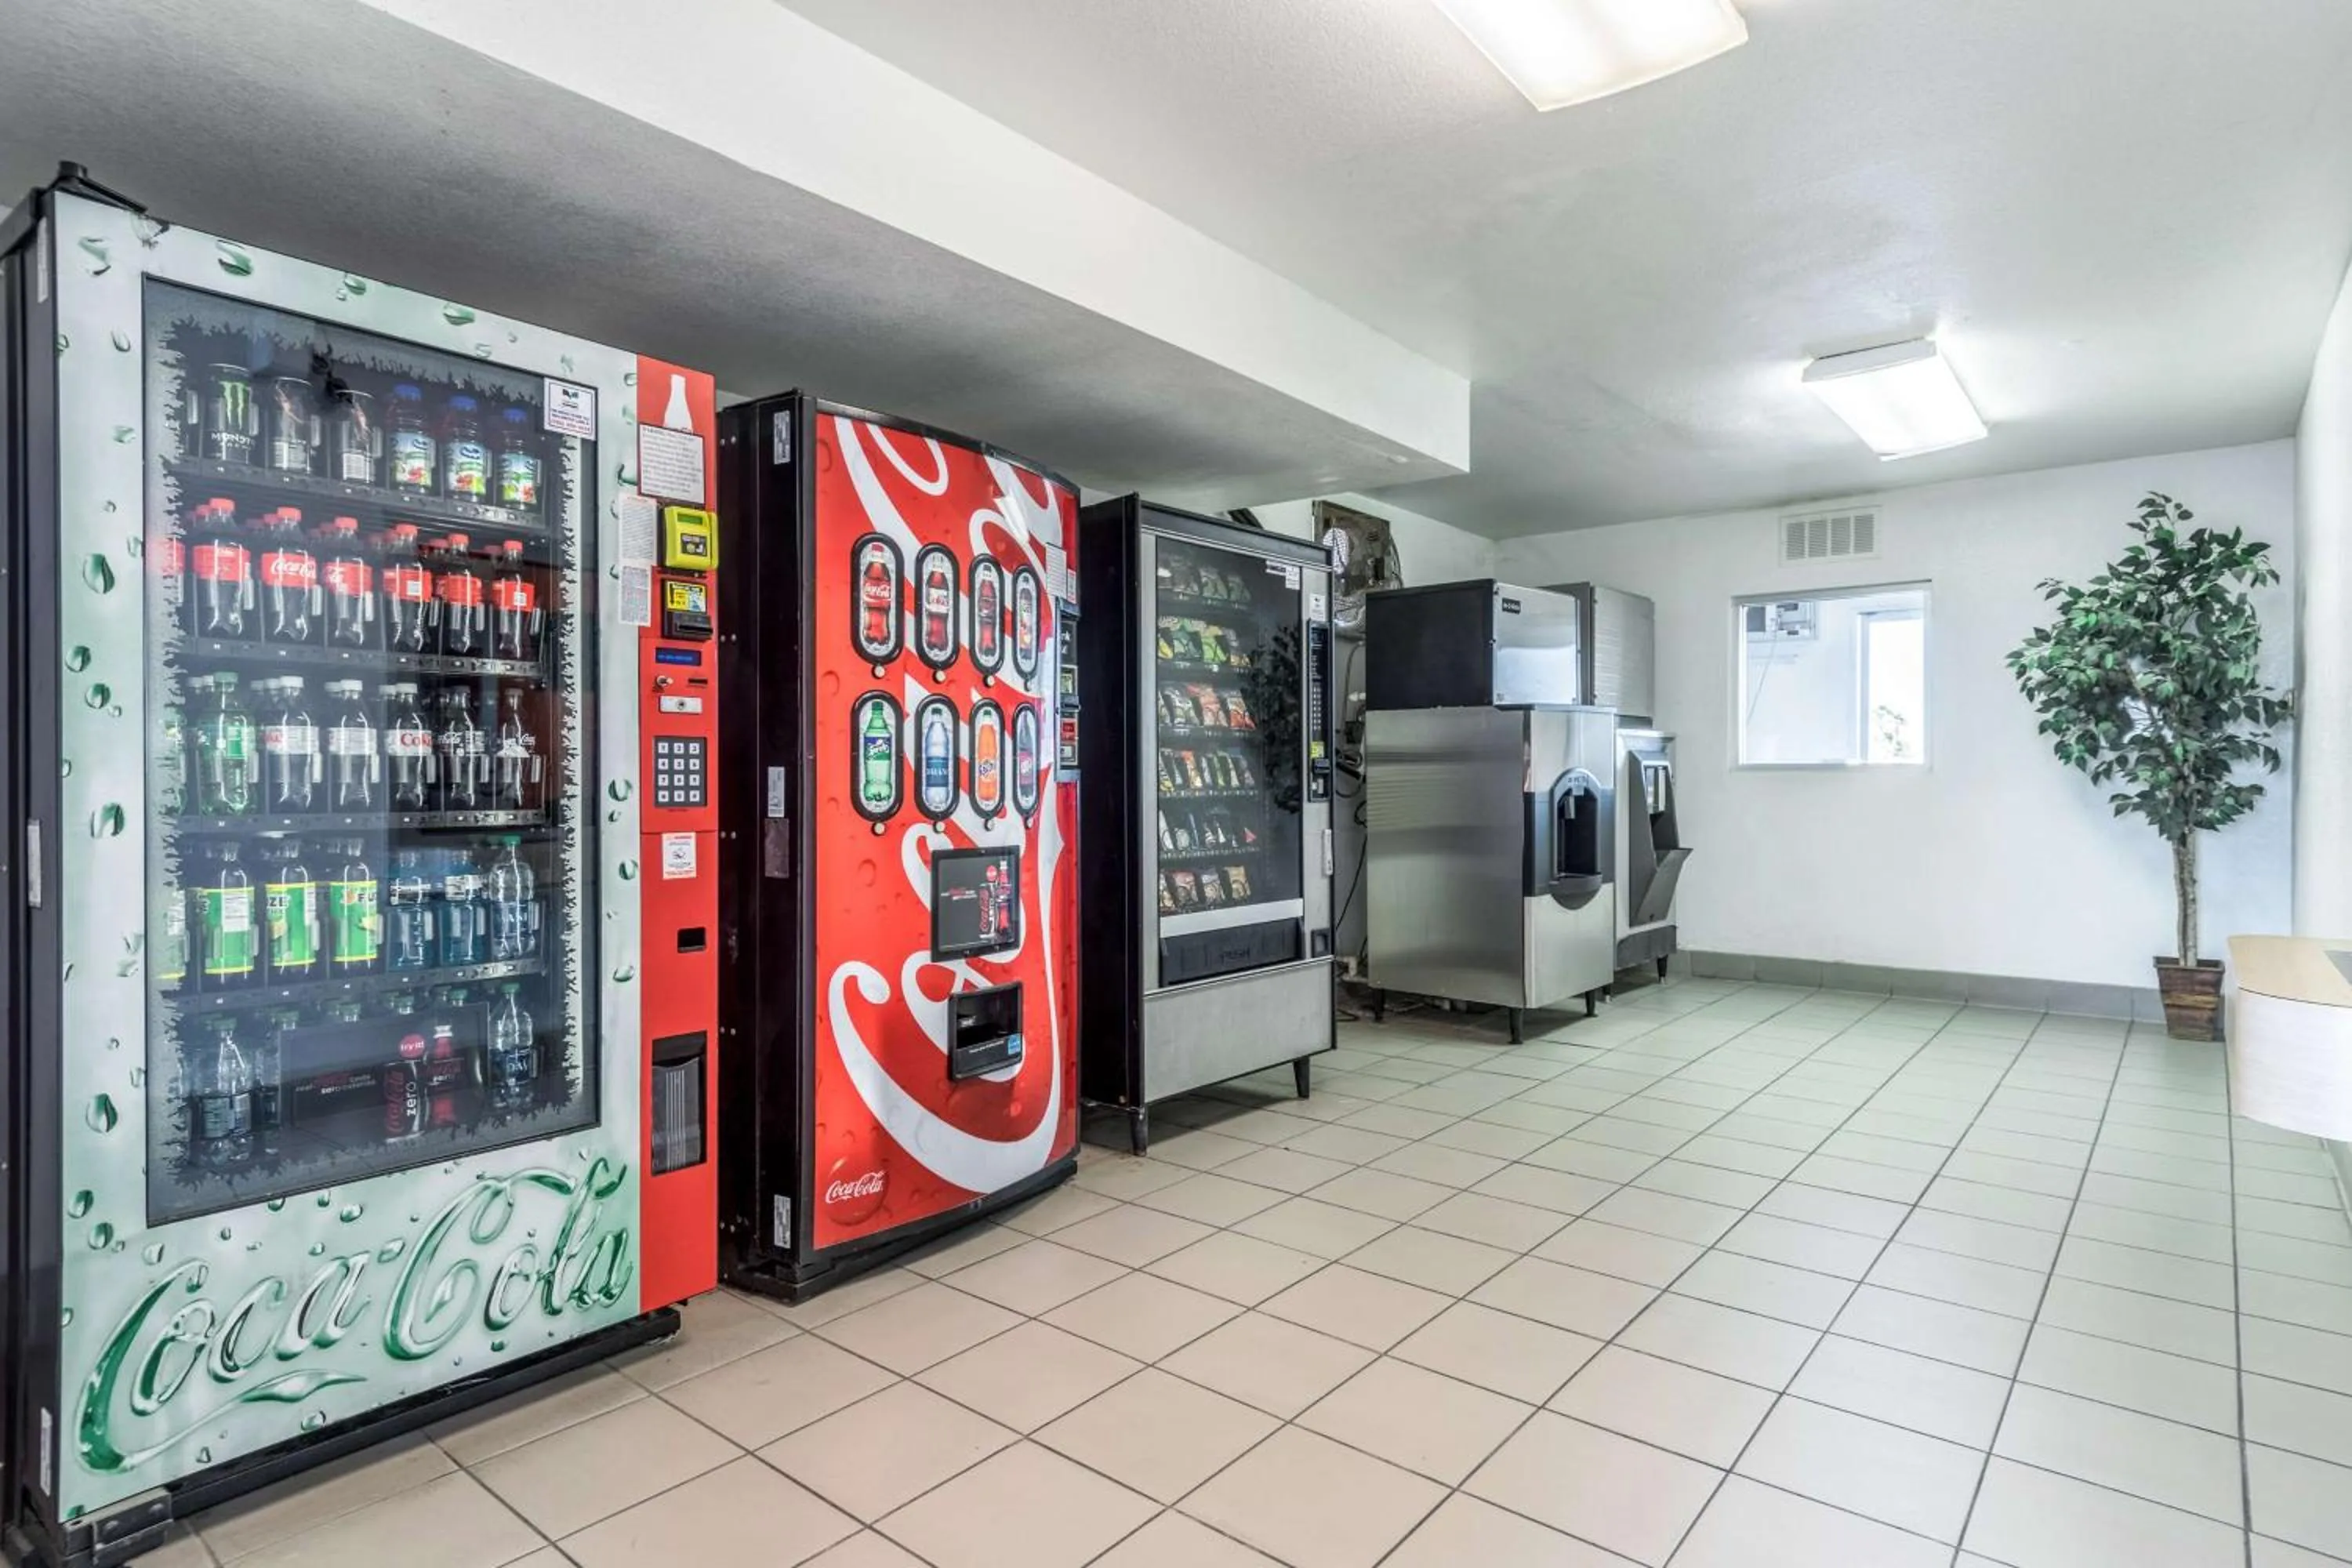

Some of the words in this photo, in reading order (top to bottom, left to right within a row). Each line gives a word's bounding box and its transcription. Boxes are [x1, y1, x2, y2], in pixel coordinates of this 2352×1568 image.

[406, 1081, 418, 1116] zero
[825, 1170, 885, 1204] Coca-Cola
[74, 1156, 633, 1474] Coca-Cola
